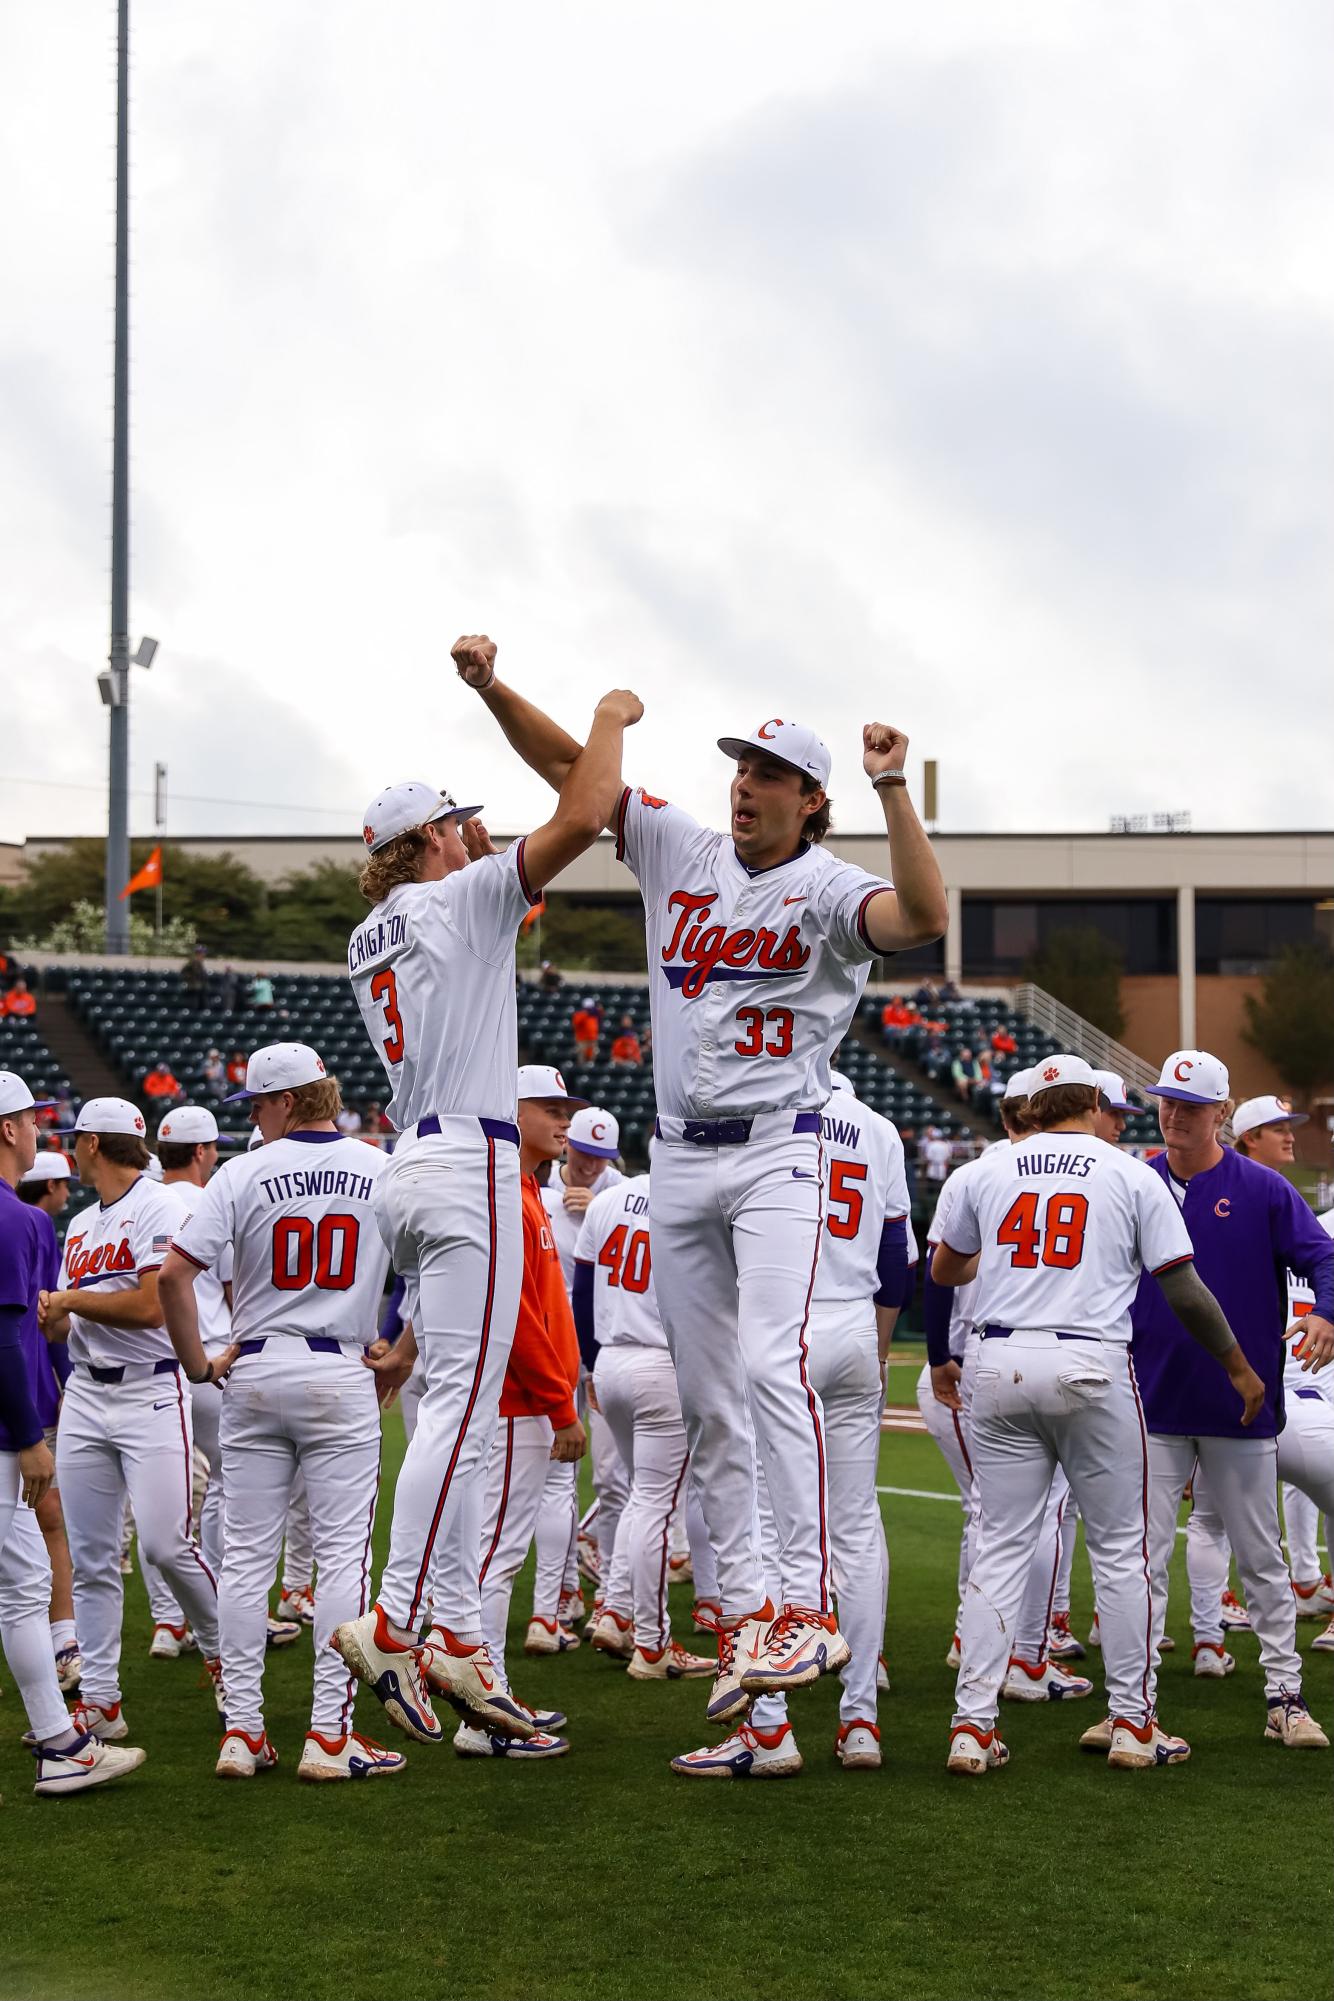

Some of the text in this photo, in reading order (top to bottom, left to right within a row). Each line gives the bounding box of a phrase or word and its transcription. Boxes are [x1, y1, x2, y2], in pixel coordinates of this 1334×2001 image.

[758, 719, 784, 740] C
[350, 913, 408, 972] CRIGHTON
[662, 890, 811, 999] Tigers
[371, 966, 404, 1066] 3
[735, 1007, 795, 1057] 33
[1174, 1061, 1194, 1082] C
[591, 1124, 606, 1140] C
[260, 1171, 374, 1204] TITSWORTH
[1017, 1154, 1096, 1177] HUGHES
[827, 1159, 868, 1240] 5
[1214, 1199, 1230, 1217] C
[271, 1214, 360, 1291] 00
[598, 1224, 651, 1294] 40
[997, 1191, 1089, 1270] 48
[66, 1231, 136, 1289] Tigers
